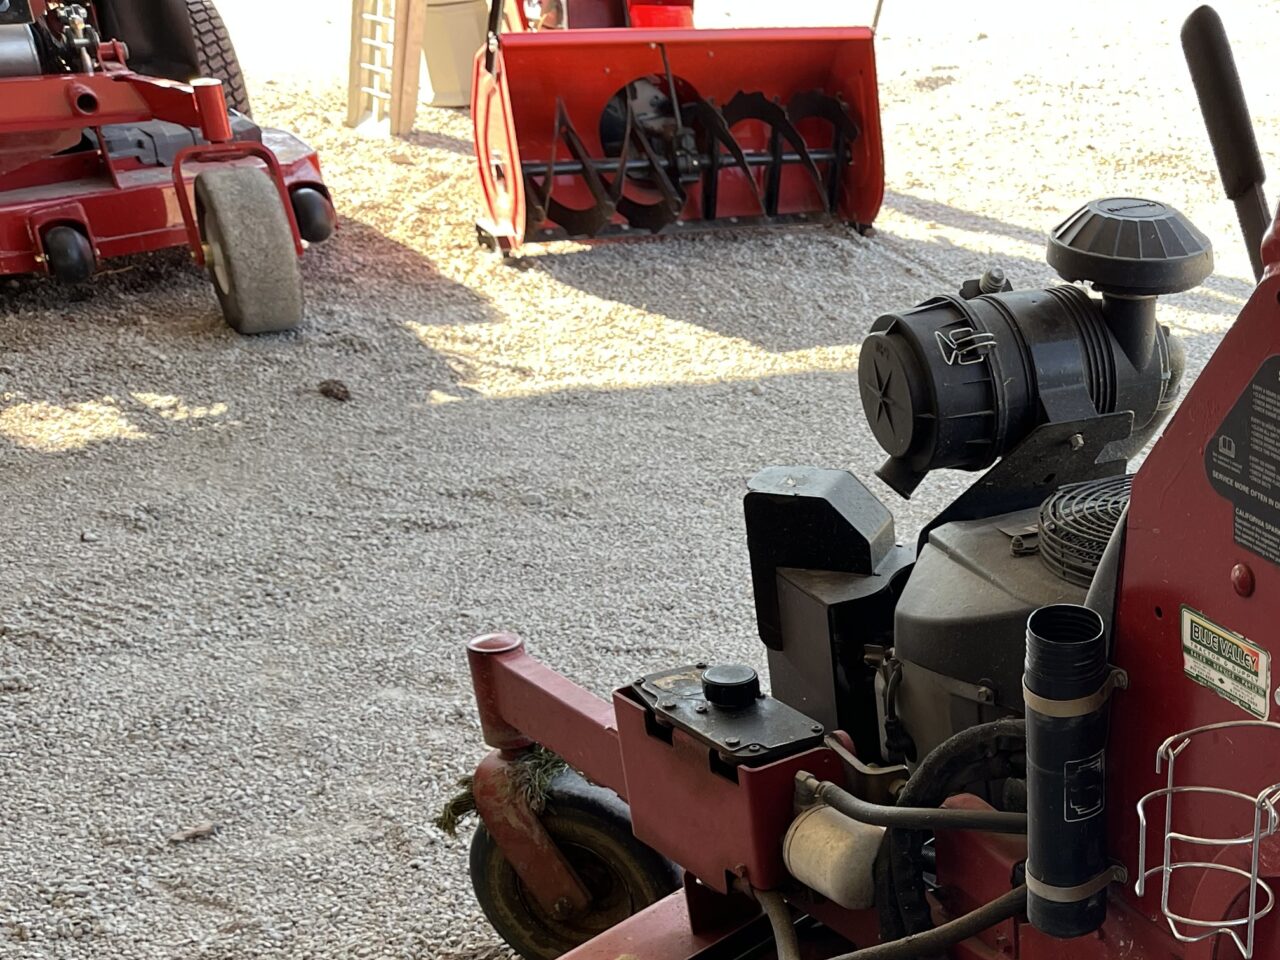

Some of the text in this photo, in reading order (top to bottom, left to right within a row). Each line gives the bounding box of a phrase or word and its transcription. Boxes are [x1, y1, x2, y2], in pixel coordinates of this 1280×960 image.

[1212, 470, 1234, 486] SERVICE
[1235, 482, 1249, 494] MORE
[1251, 489, 1267, 502] OFTEN
[1268, 498, 1274, 506] IN
[1236, 508, 1264, 528] CALIFORNIA
[1265, 522, 1280, 536] SPARK
[1190, 642, 1220, 662] TRACTOR
[1232, 664, 1258, 683] SUPPLY
[1192, 622, 1219, 651] BLUE
[1219, 636, 1257, 671] VALLEY
